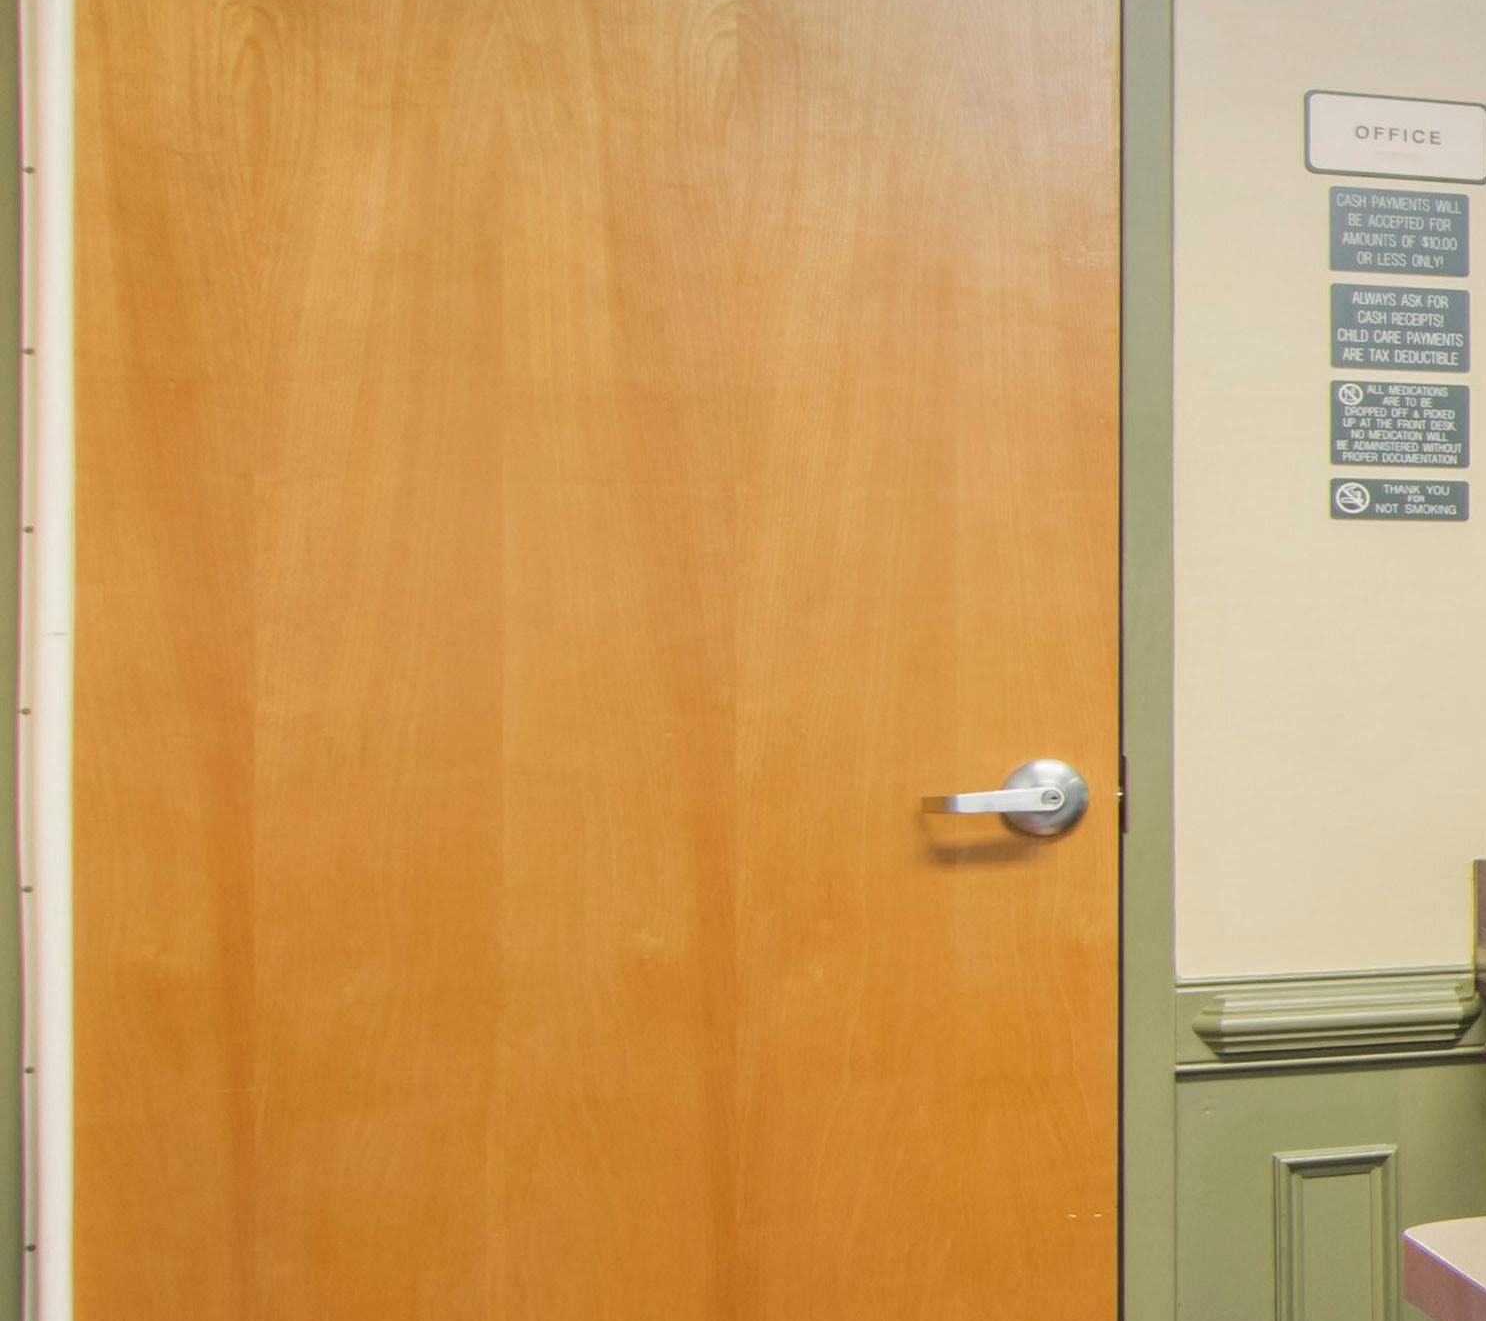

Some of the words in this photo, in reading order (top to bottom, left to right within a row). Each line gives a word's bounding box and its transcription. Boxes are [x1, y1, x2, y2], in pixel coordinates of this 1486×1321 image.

[1355, 125, 1442, 146] OFFICE
[1336, 193, 1367, 208] CASH
[1371, 195, 1430, 212] PAYMENTS
[1435, 199, 1462, 214] WILL
[1348, 213, 1362, 227] BE
[1368, 214, 1424, 230] ACCEPTED
[1429, 218, 1452, 232] FOR
[1342, 231, 1397, 248] AMOUNTS
[1401, 235, 1416, 248] OF
[1422, 235, 1458, 251] $10.00
[1357, 251, 1372, 265] OR
[1377, 252, 1407, 267] LESS
[1411, 254, 1444, 268] ONLY!
[1352, 291, 1397, 307] ALWAYS
[1401, 293, 1423, 308] ASK
[1428, 295, 1449, 309] FOR
[1357, 309, 1387, 325] CASH
[1391, 311, 1444, 328] RECEIPTS!
[1337, 328, 1369, 343] CHILD
[1373, 329, 1402, 345] CARE
[1406, 331, 1464, 347] PAYMENTS
[1342, 347, 1364, 362] ARE
[1369, 348, 1390, 362] TAX
[1394, 349, 1459, 366] DEDUCTIBLE
[1366, 384, 1384, 395] ALL
[1388, 385, 1448, 398] MEDICATIONS
[1382, 397, 1400, 407] ARE
[1405, 397, 1417, 407] TO
[1420, 398, 1433, 408] BE
[1344, 406, 1387, 418] DROPPED
[1391, 408, 1408, 418] OFF
[1423, 409, 1456, 420] PICKED
[1343, 418, 1356, 428] UP
[1360, 418, 1371, 428] AT
[1376, 418, 1393, 429] THE
[1397, 419, 1426, 430] FRONT
[1350, 429, 1365, 439] NO
[1368, 430, 1424, 441] MEDICATION
[1426, 431, 1448, 442] WILL
[1336, 440, 1349, 450] BE
[1353, 441, 1419, 452] ADMINISTERED
[1422, 442, 1462, 453] WITHOUT
[1342, 451, 1379, 462] PROPER
[1382, 453, 1458, 465] DOCUMENTATION
[1383, 484, 1421, 495] THANK
[1425, 485, 1450, 496] YOU
[1407, 495, 1425, 503] FOR
[1375, 503, 1399, 514] NOT
[1404, 503, 1457, 515] SMOKING
